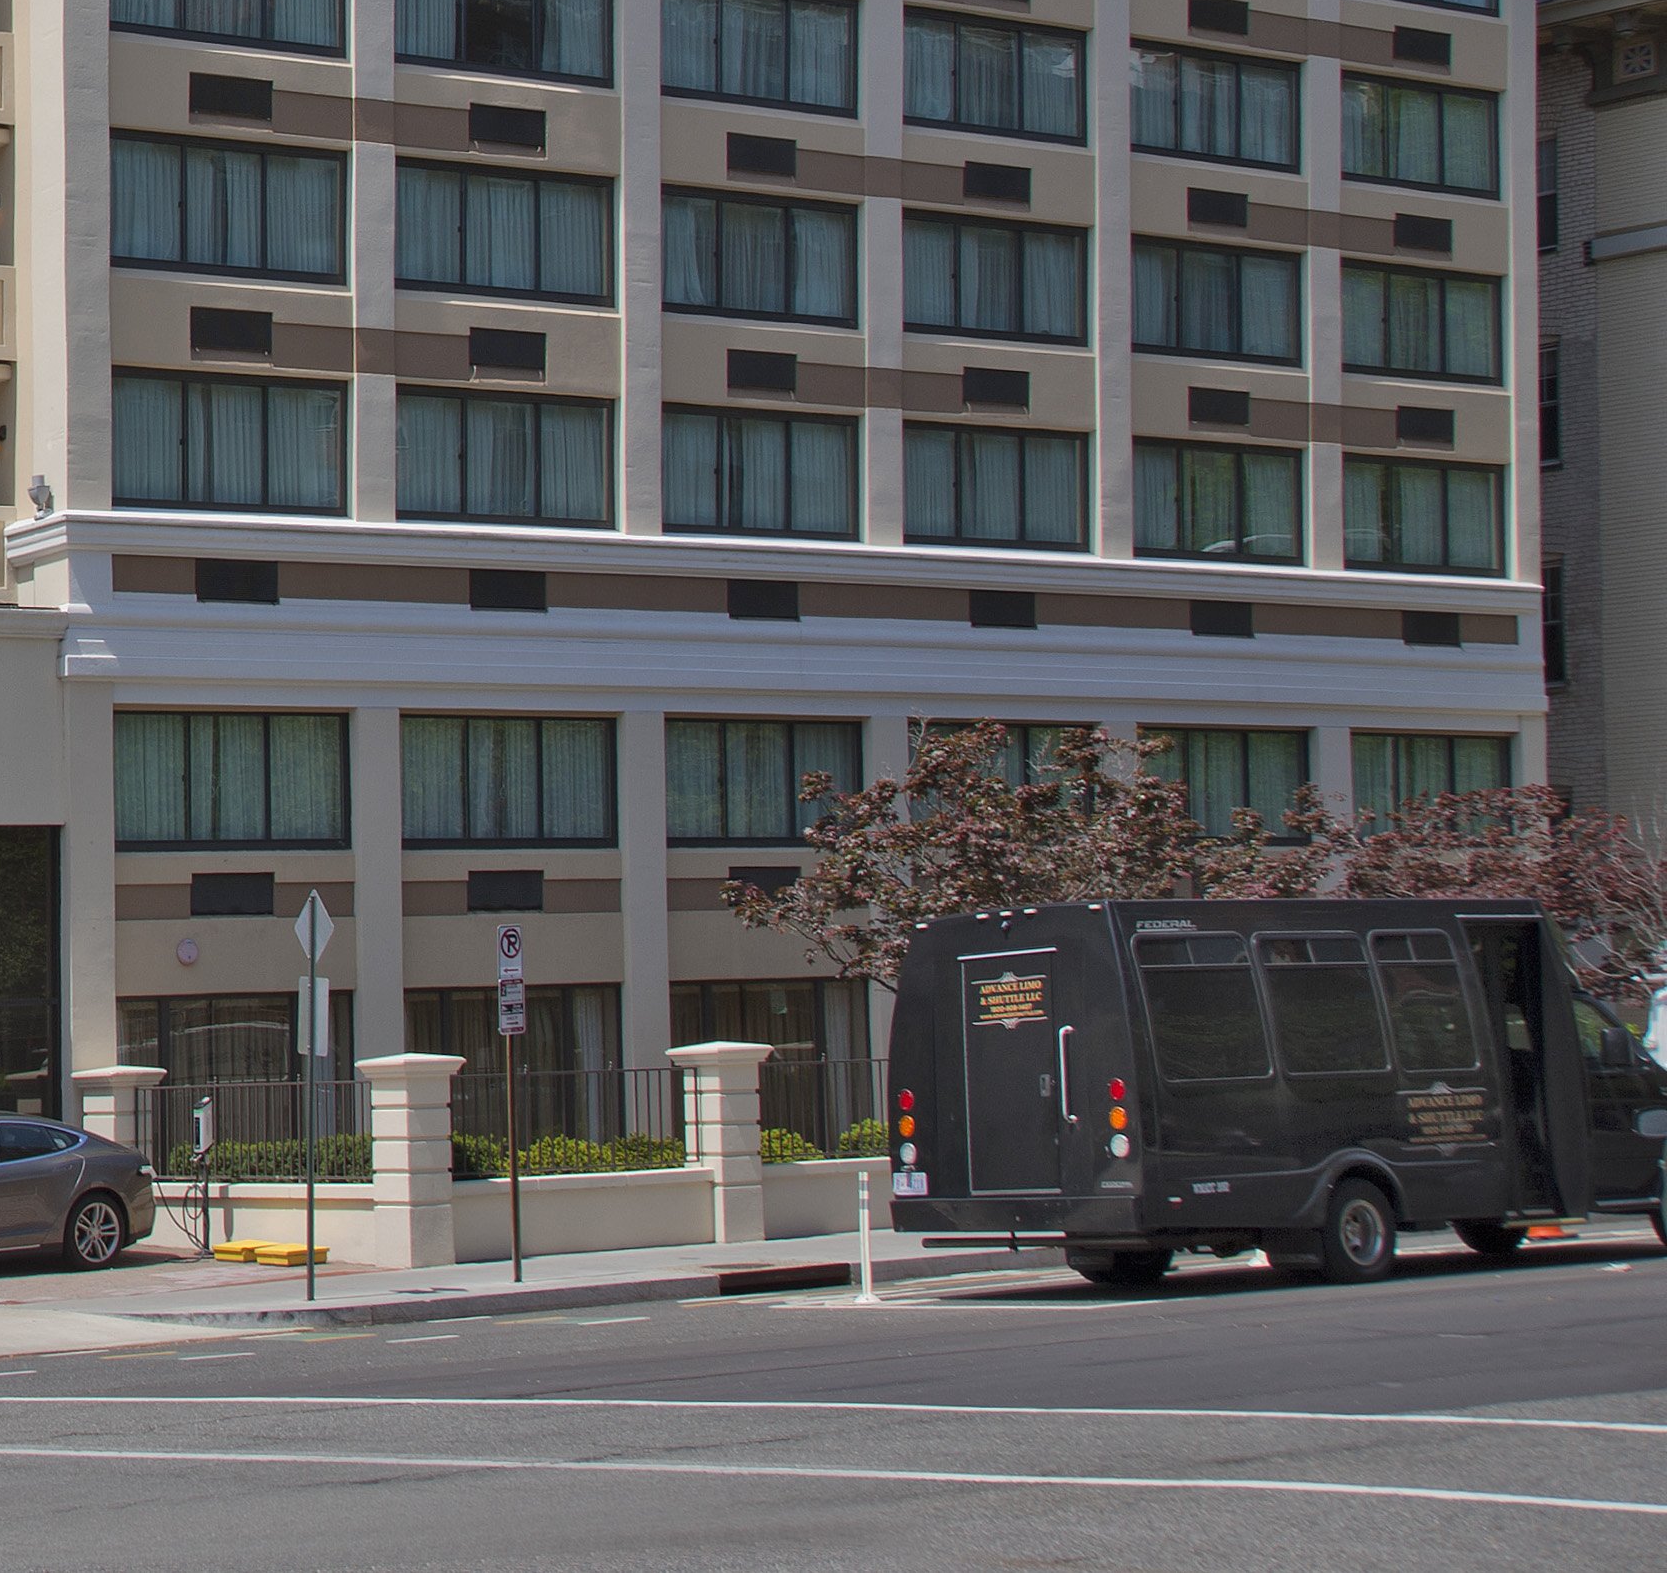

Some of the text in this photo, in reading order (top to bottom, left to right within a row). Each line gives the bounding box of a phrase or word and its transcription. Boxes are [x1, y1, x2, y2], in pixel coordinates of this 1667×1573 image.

[1136, 919, 1195, 929] FEDERAL
[979, 979, 1043, 995] ADVANCE LIMO
[987, 993, 1025, 1005] SHUTTLE
[1026, 992, 1043, 1002] LLC
